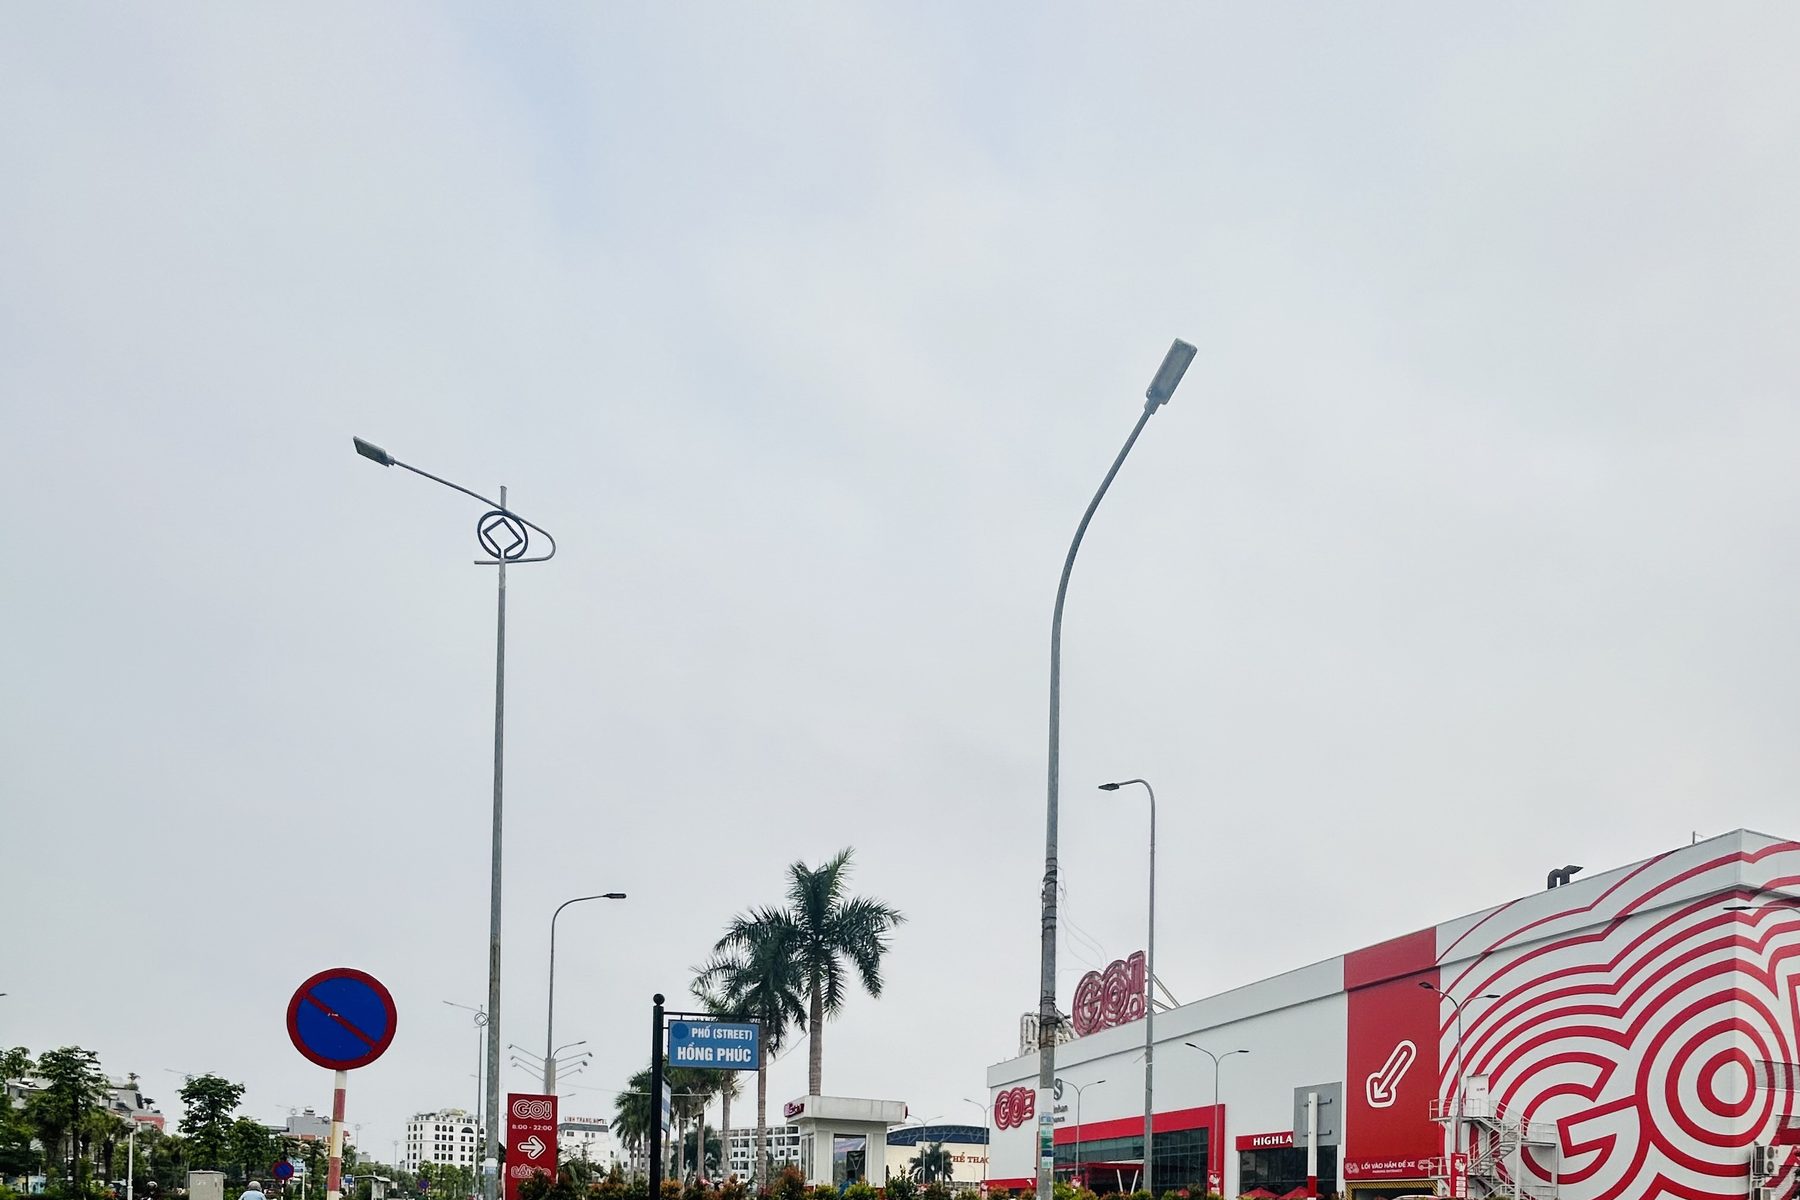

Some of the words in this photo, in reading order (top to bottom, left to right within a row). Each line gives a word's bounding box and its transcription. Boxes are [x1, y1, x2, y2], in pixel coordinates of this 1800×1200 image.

[1072, 950, 1146, 1037] GO!
[691, 1025, 711, 1038] PHỐ
[713, 1028, 753, 1041] (STREET)
[677, 1042, 713, 1061] HỒNG
[717, 1045, 751, 1062] PHÚC
[513, 1099, 552, 1120] GO!
[994, 1087, 1036, 1130] GO!
[1253, 1135, 1293, 1146] HIGHLA
